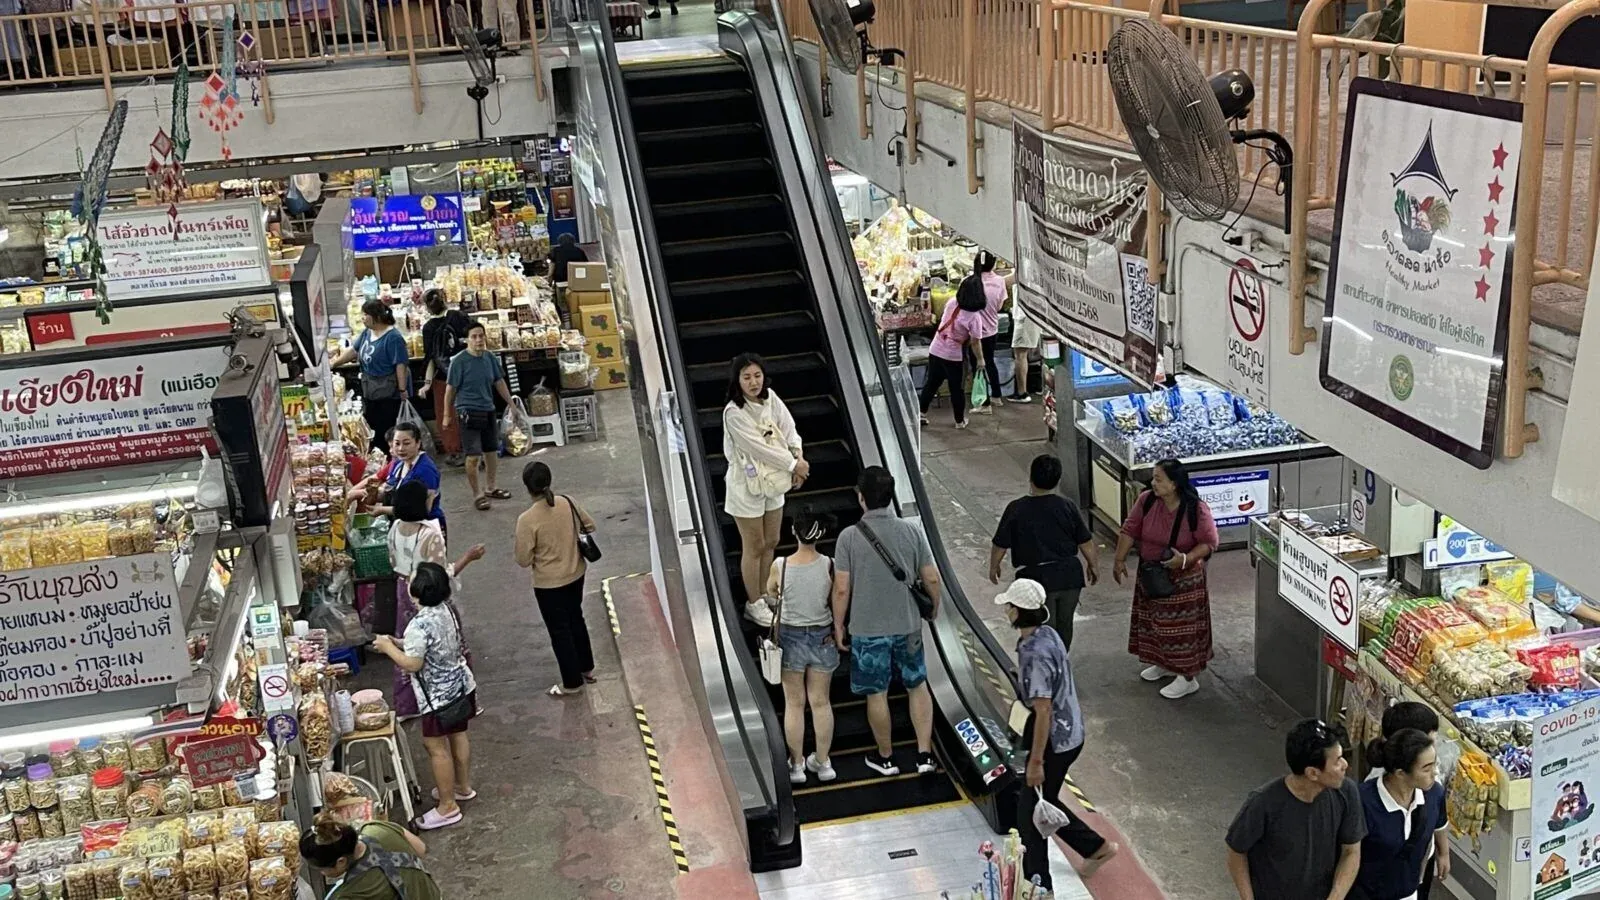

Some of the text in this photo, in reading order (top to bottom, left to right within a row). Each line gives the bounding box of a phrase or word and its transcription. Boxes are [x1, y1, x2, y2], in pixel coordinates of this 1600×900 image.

[1412, 278, 1440, 292] Market
[1078, 300, 1099, 321] 2568
[37, 321, 65, 335] ร้าน
[156, 420, 171, 429] และ
[175, 417, 196, 427] GMP
[1283, 537, 1328, 581] ห้ามสูบบุหรี่
[1282, 569, 1326, 610] NO SMOKING
[80, 591, 171, 624] หมูยอป้าย่น
[75, 651, 143, 673] กาละแม
